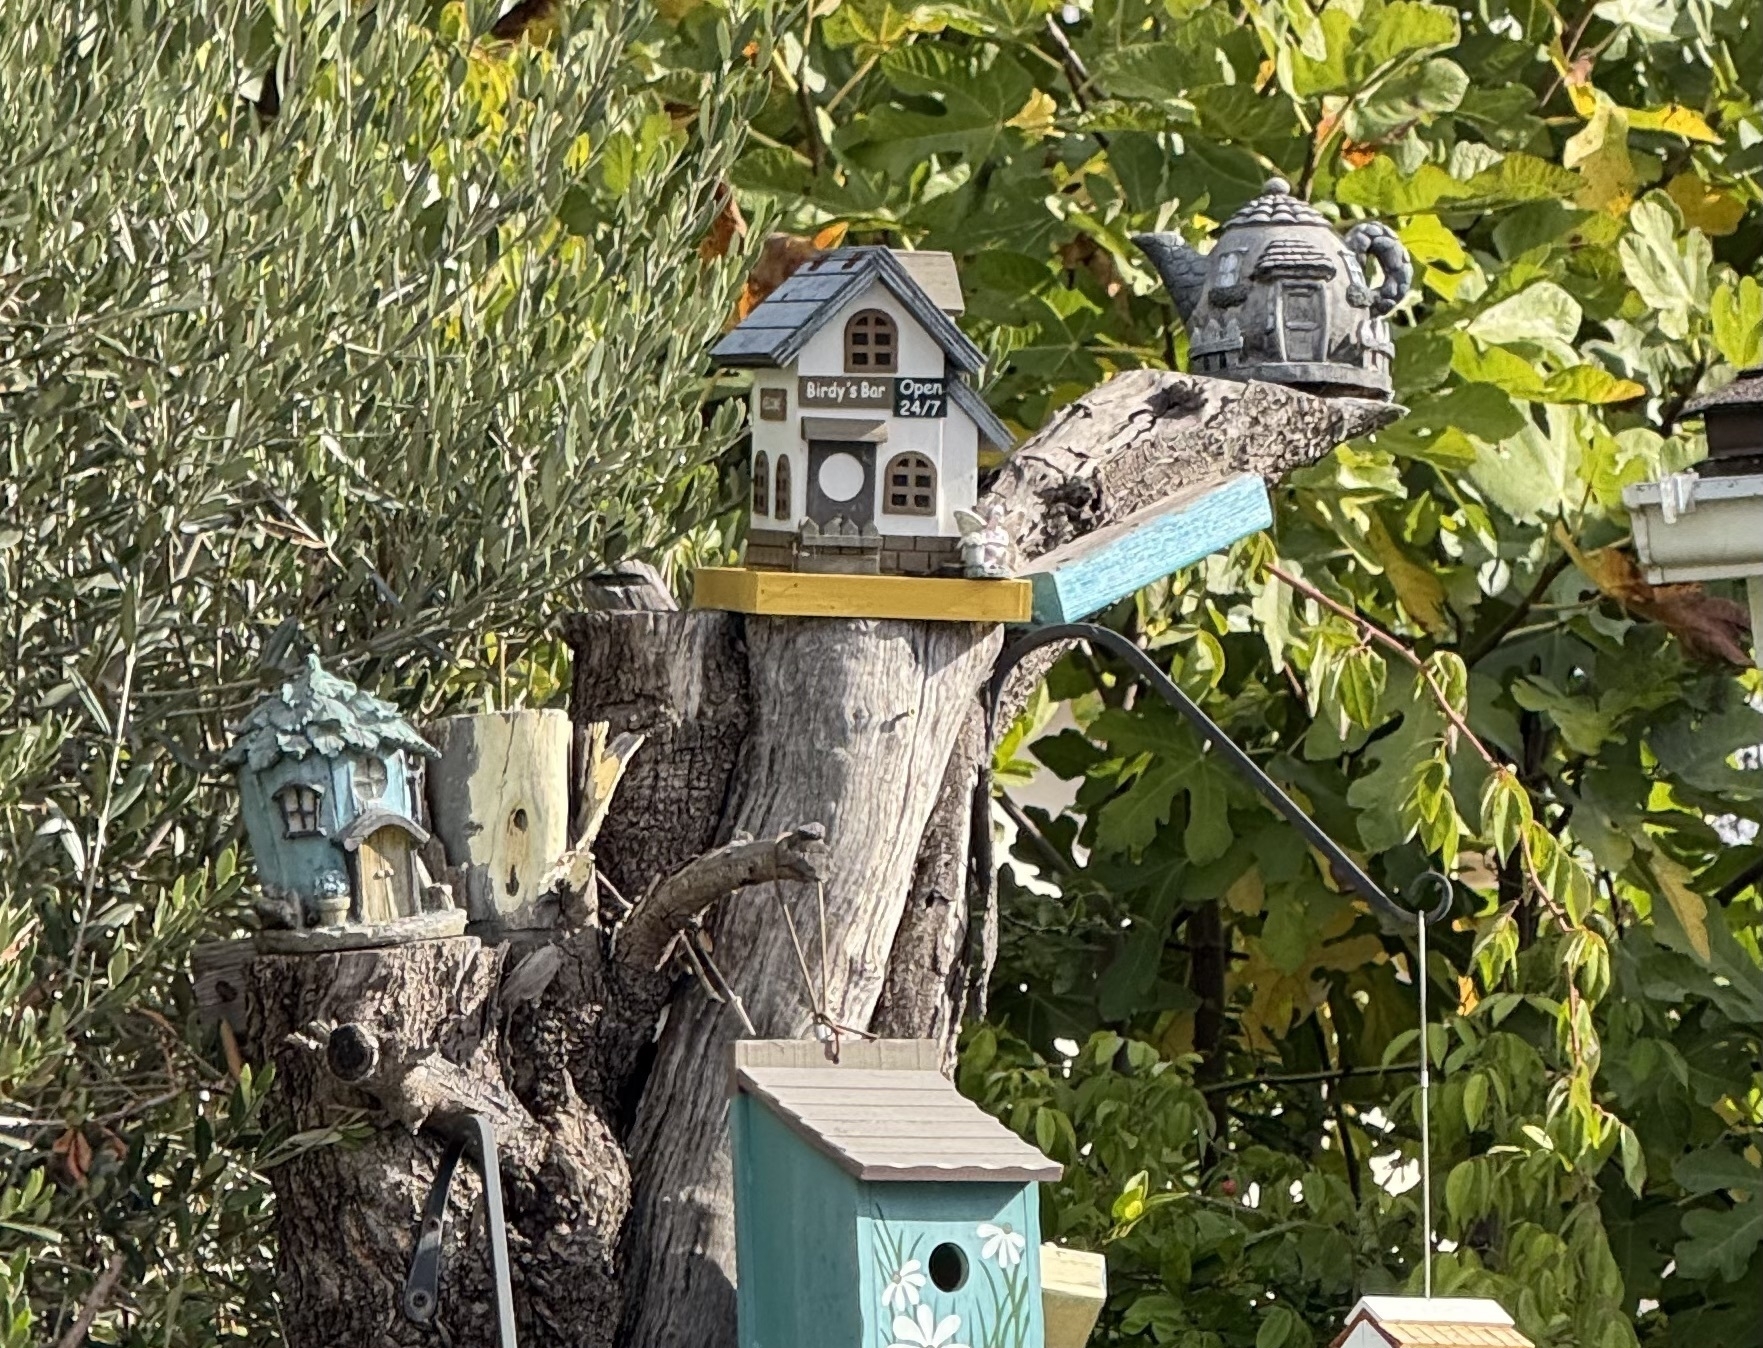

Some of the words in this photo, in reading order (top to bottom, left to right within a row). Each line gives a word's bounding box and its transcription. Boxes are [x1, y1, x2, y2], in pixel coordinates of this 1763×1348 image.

[807, 381, 857, 402] Birdy's
[860, 381, 886, 398] Bar
[900, 379, 942, 398] Open
[900, 400, 941, 416] 24/7
